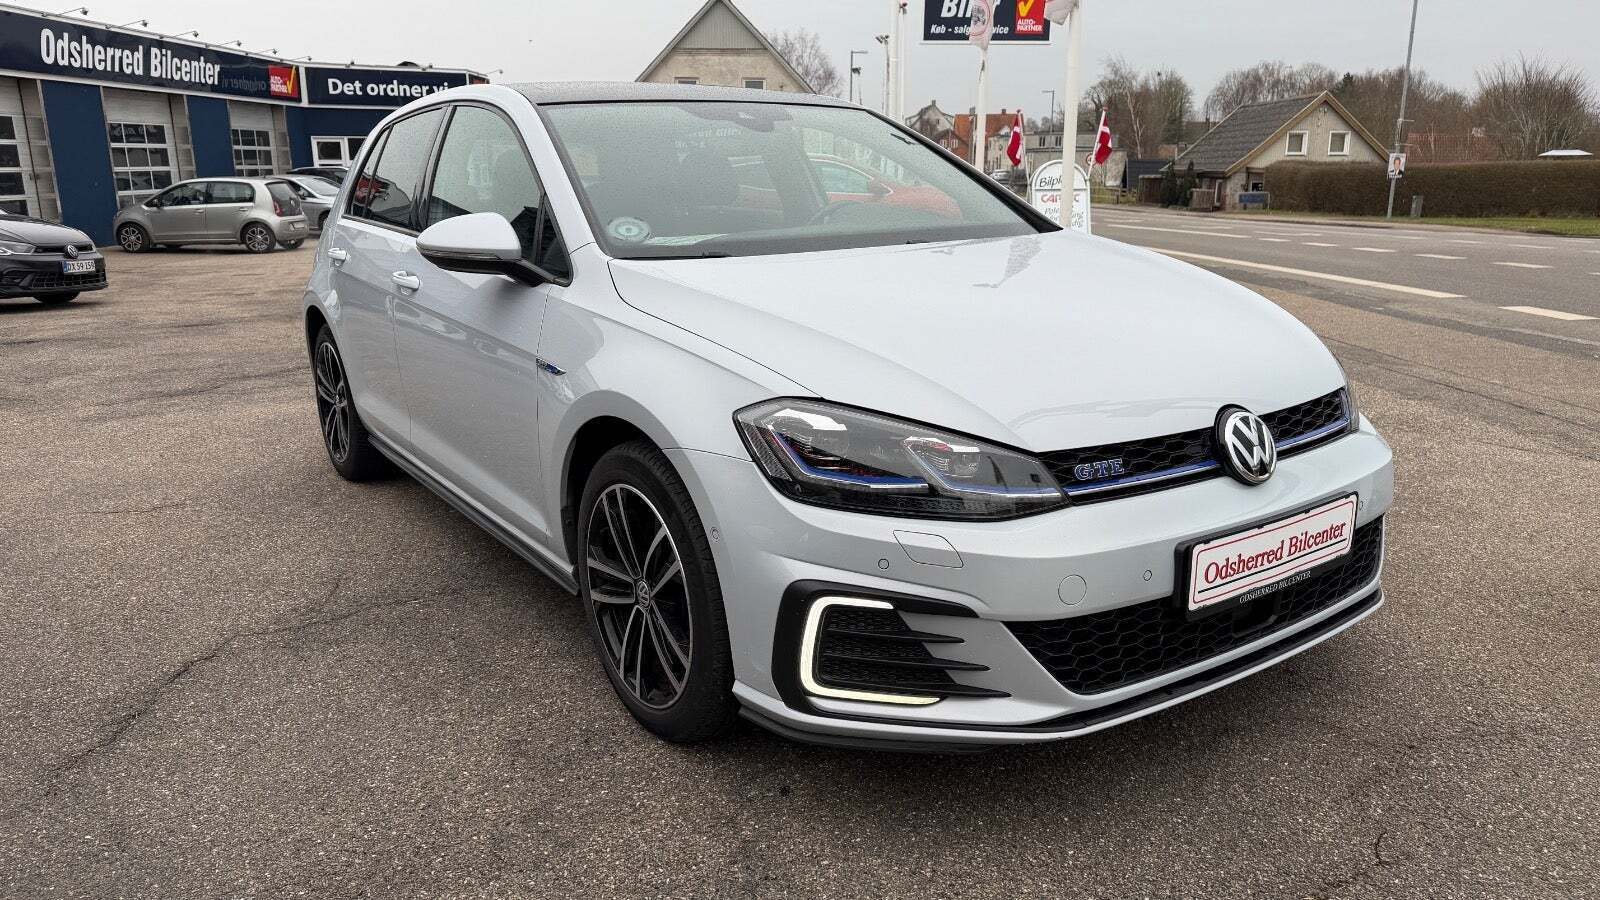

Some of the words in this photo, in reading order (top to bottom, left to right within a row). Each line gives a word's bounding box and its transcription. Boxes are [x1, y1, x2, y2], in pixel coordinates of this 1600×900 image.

[40, 28, 144, 76] Odsherred
[150, 47, 220, 85] Bilcenter
[327, 78, 363, 95] Det
[366, 79, 430, 97] ordner
[1074, 458, 1125, 480] GTE
[1204, 539, 1284, 584] Odsherred
[1287, 521, 1347, 558] Bilcenter
[1239, 583, 1277, 604] ODSHERRED
